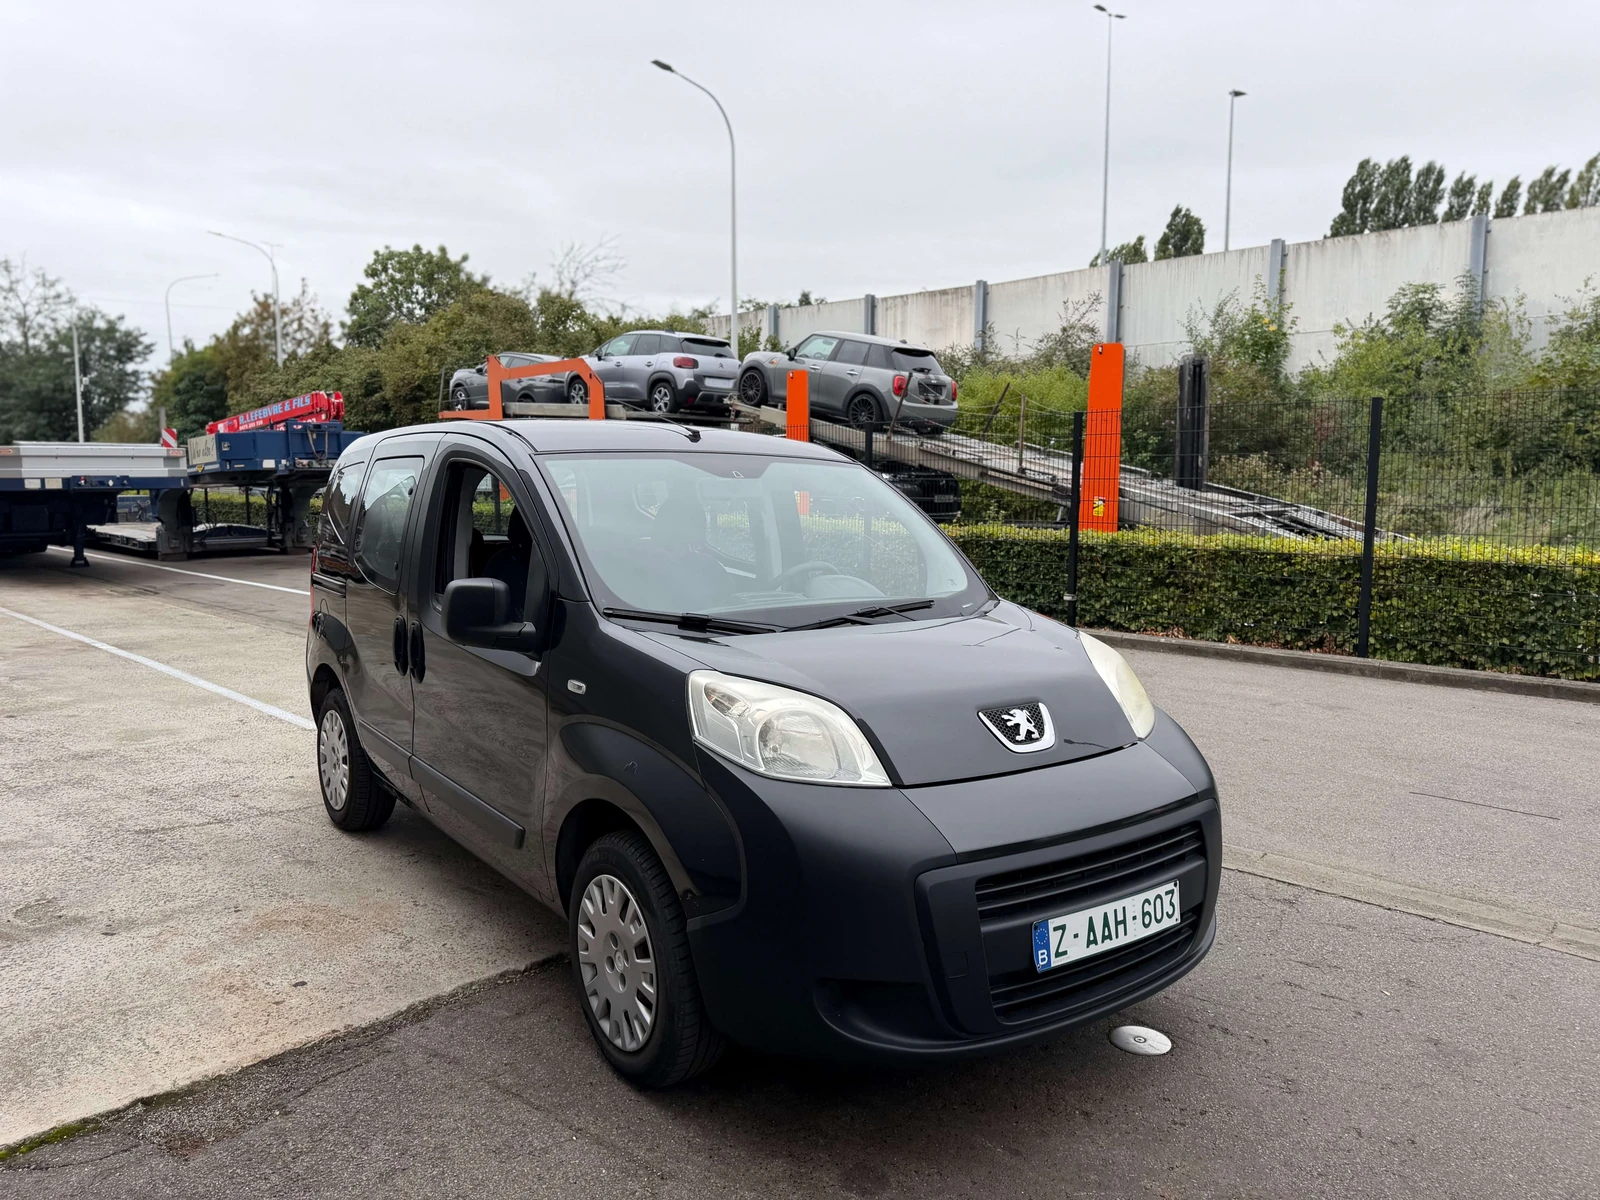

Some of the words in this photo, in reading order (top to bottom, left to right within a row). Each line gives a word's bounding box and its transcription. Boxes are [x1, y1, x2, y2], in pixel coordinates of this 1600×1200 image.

[239, 404, 283, 425] R.LEFEBVRE
[284, 401, 291, 412] &
[292, 395, 311, 409] FILS
[1053, 889, 1176, 958] Z-AAH-603
[1038, 949, 1049, 965] B
